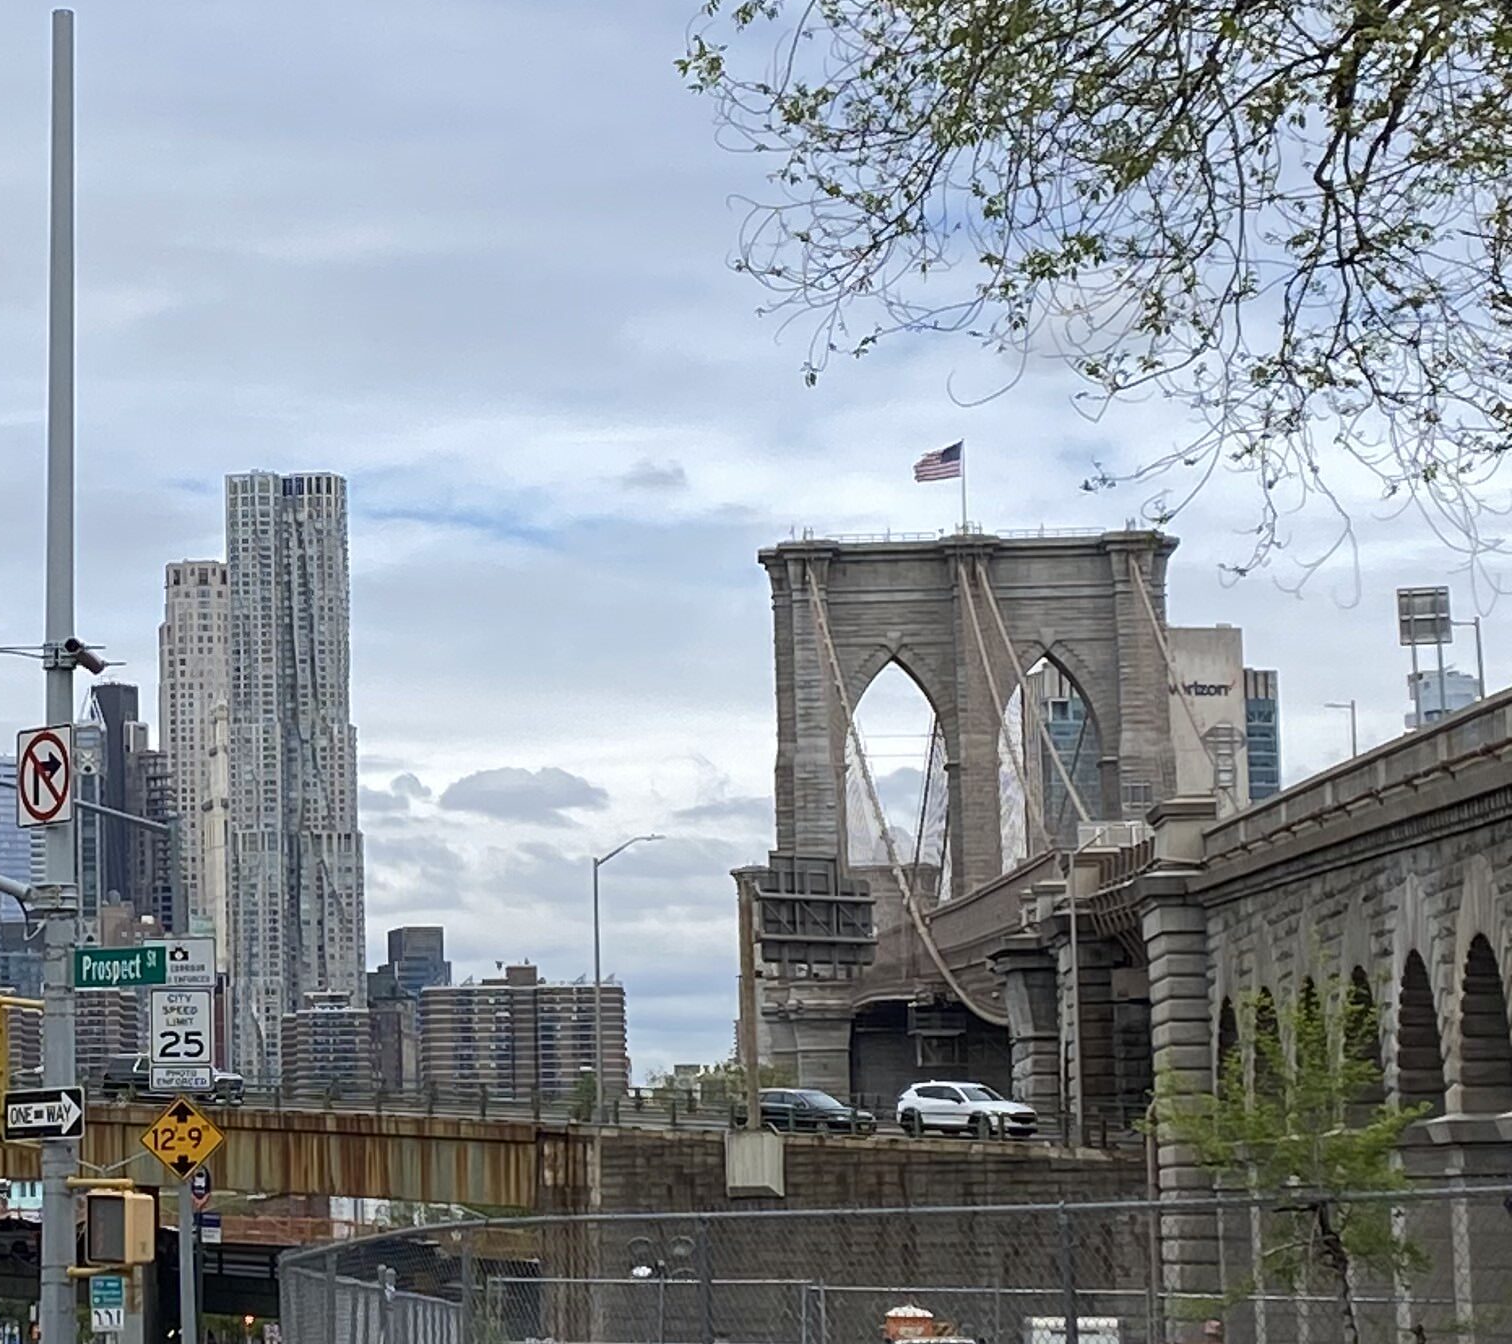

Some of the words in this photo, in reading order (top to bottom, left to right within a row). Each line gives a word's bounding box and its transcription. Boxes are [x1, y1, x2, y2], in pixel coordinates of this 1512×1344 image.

[82, 953, 142, 985] Prospect
[167, 994, 193, 1004] CITY
[163, 1006, 198, 1016] SPEED
[166, 1017, 195, 1027] LIMIT
[159, 1031, 205, 1058] 25
[165, 1069, 198, 1078] PHOTO
[156, 1077, 207, 1087] ENFORCED
[10, 1106, 33, 1125] ONE
[46, 1103, 72, 1123] WAY
